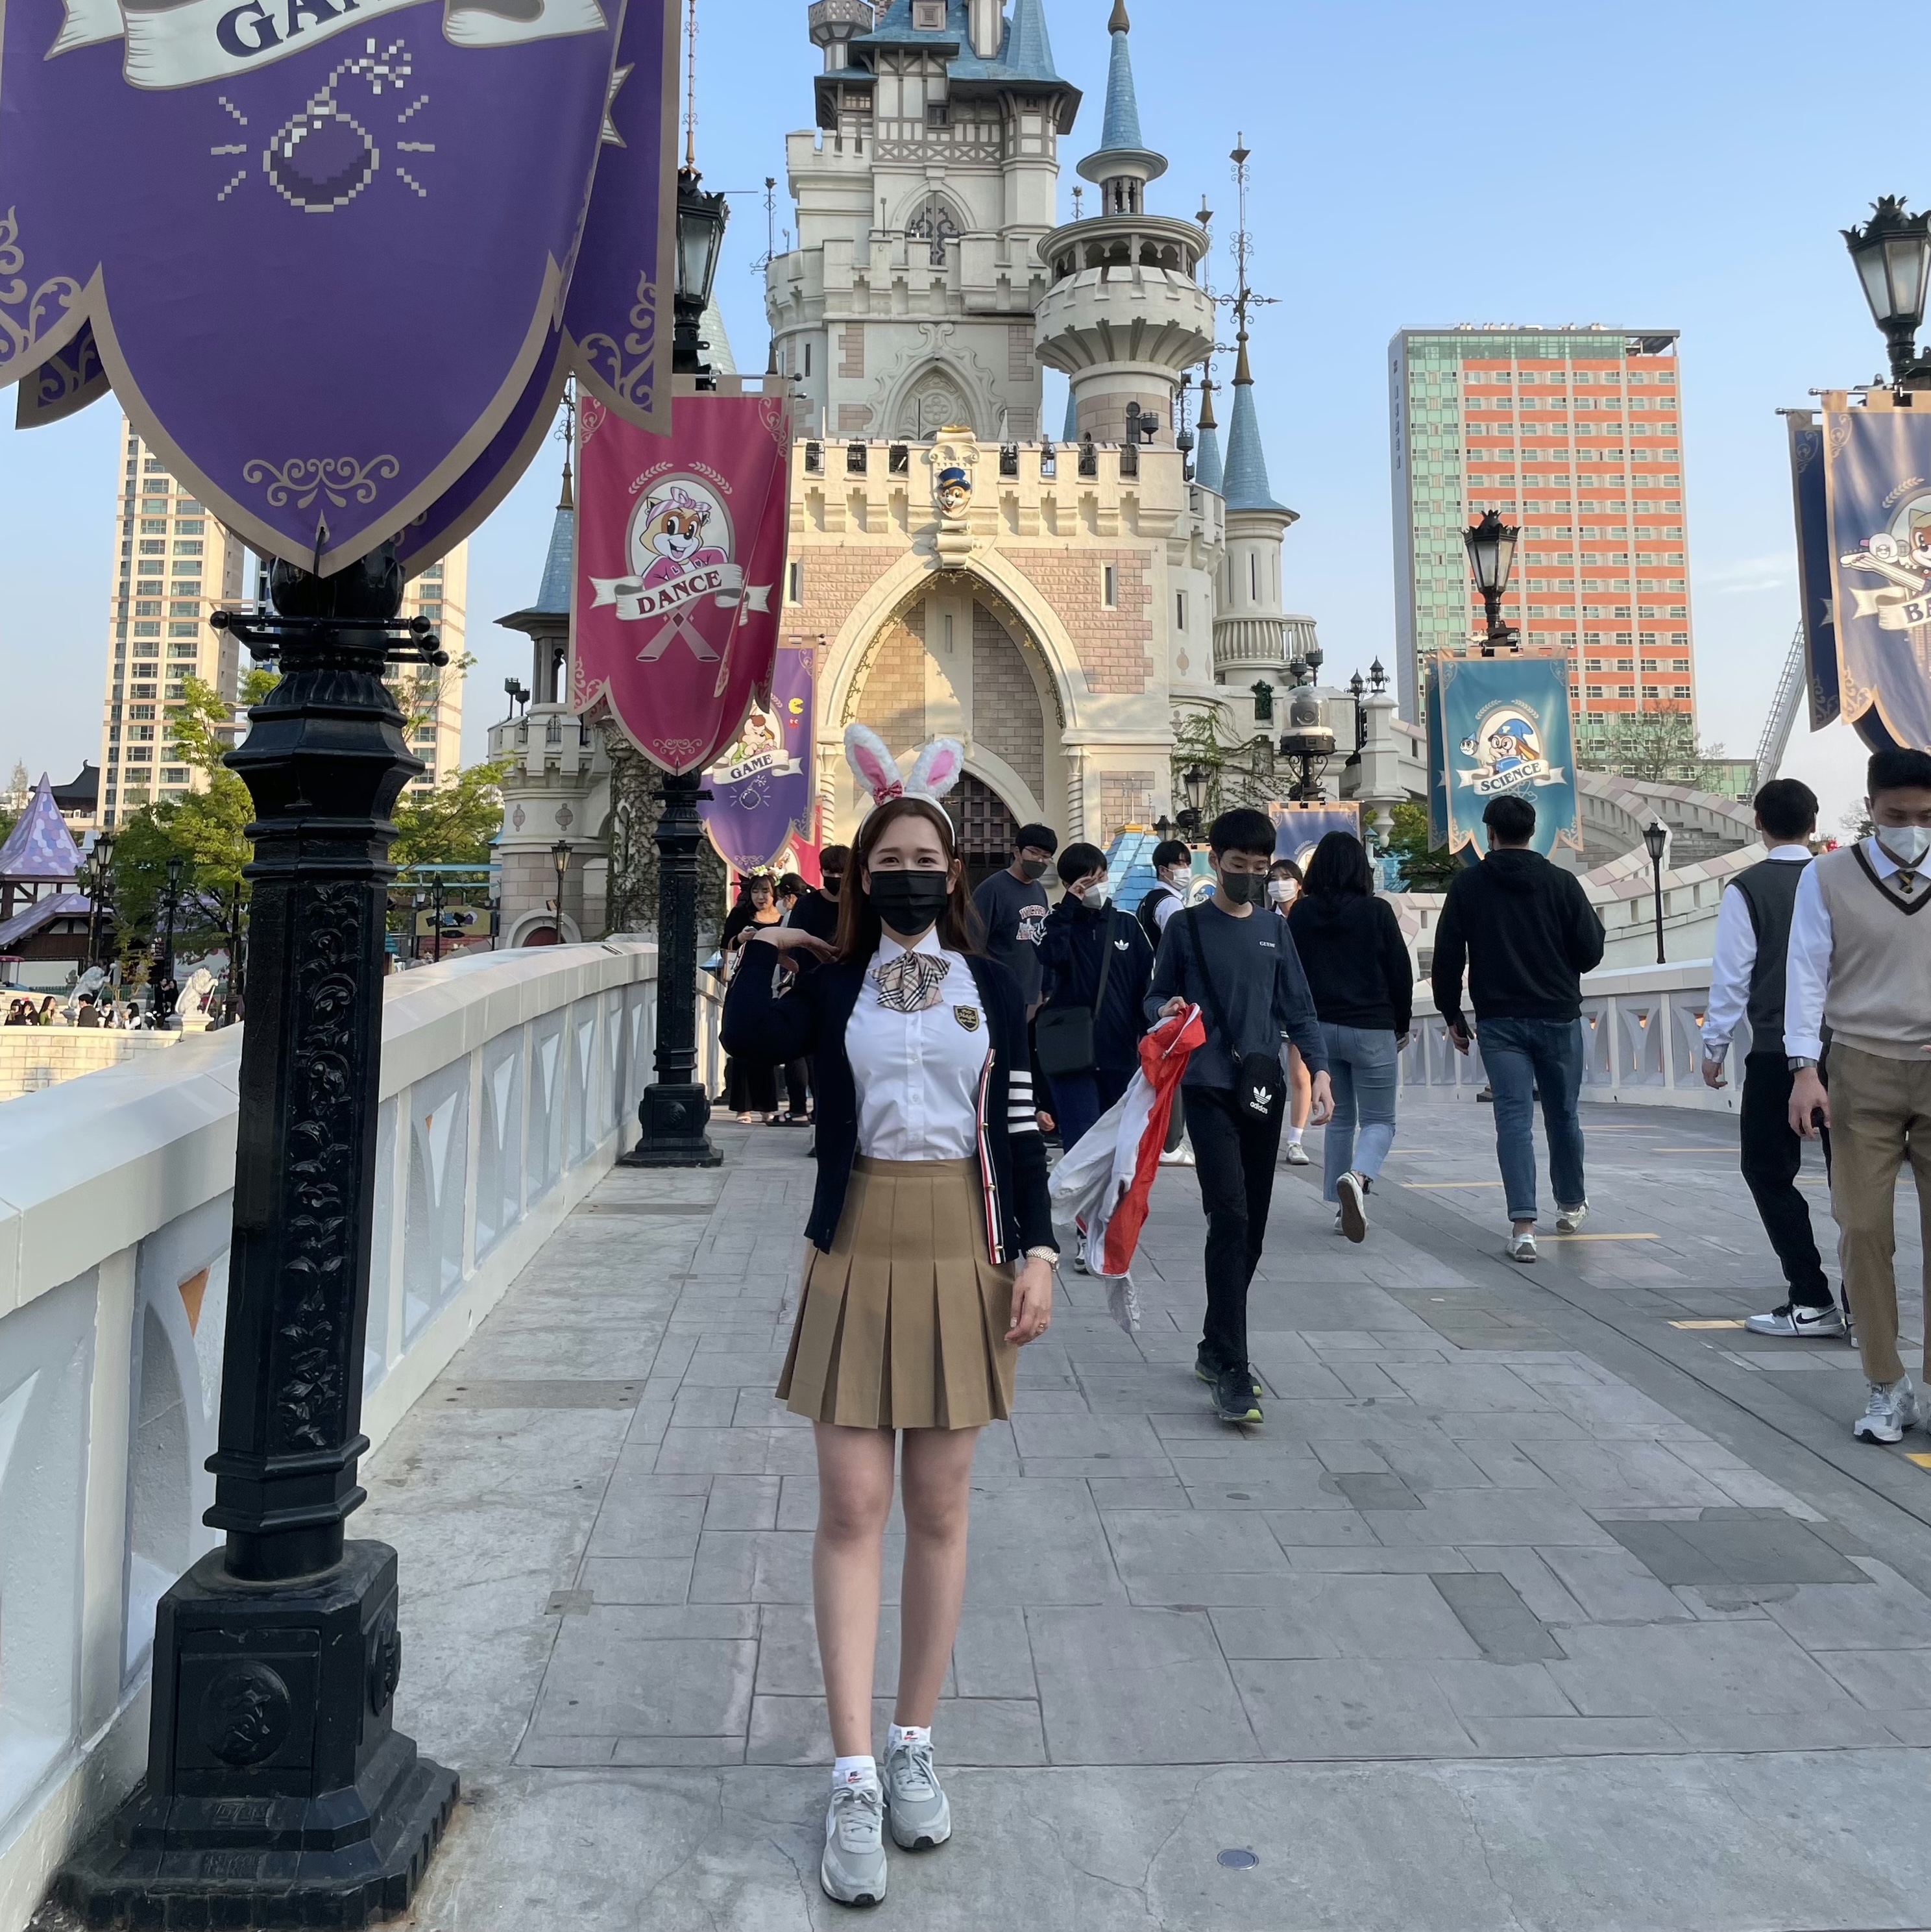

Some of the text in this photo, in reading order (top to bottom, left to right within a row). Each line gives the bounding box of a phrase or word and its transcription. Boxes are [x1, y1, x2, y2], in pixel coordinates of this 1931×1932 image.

[636, 570, 722, 615] DANCE
[731, 754, 773, 779] GAME
[1481, 763, 1541, 792] SCIENCE
[1250, 1101, 1268, 1114] adidas
